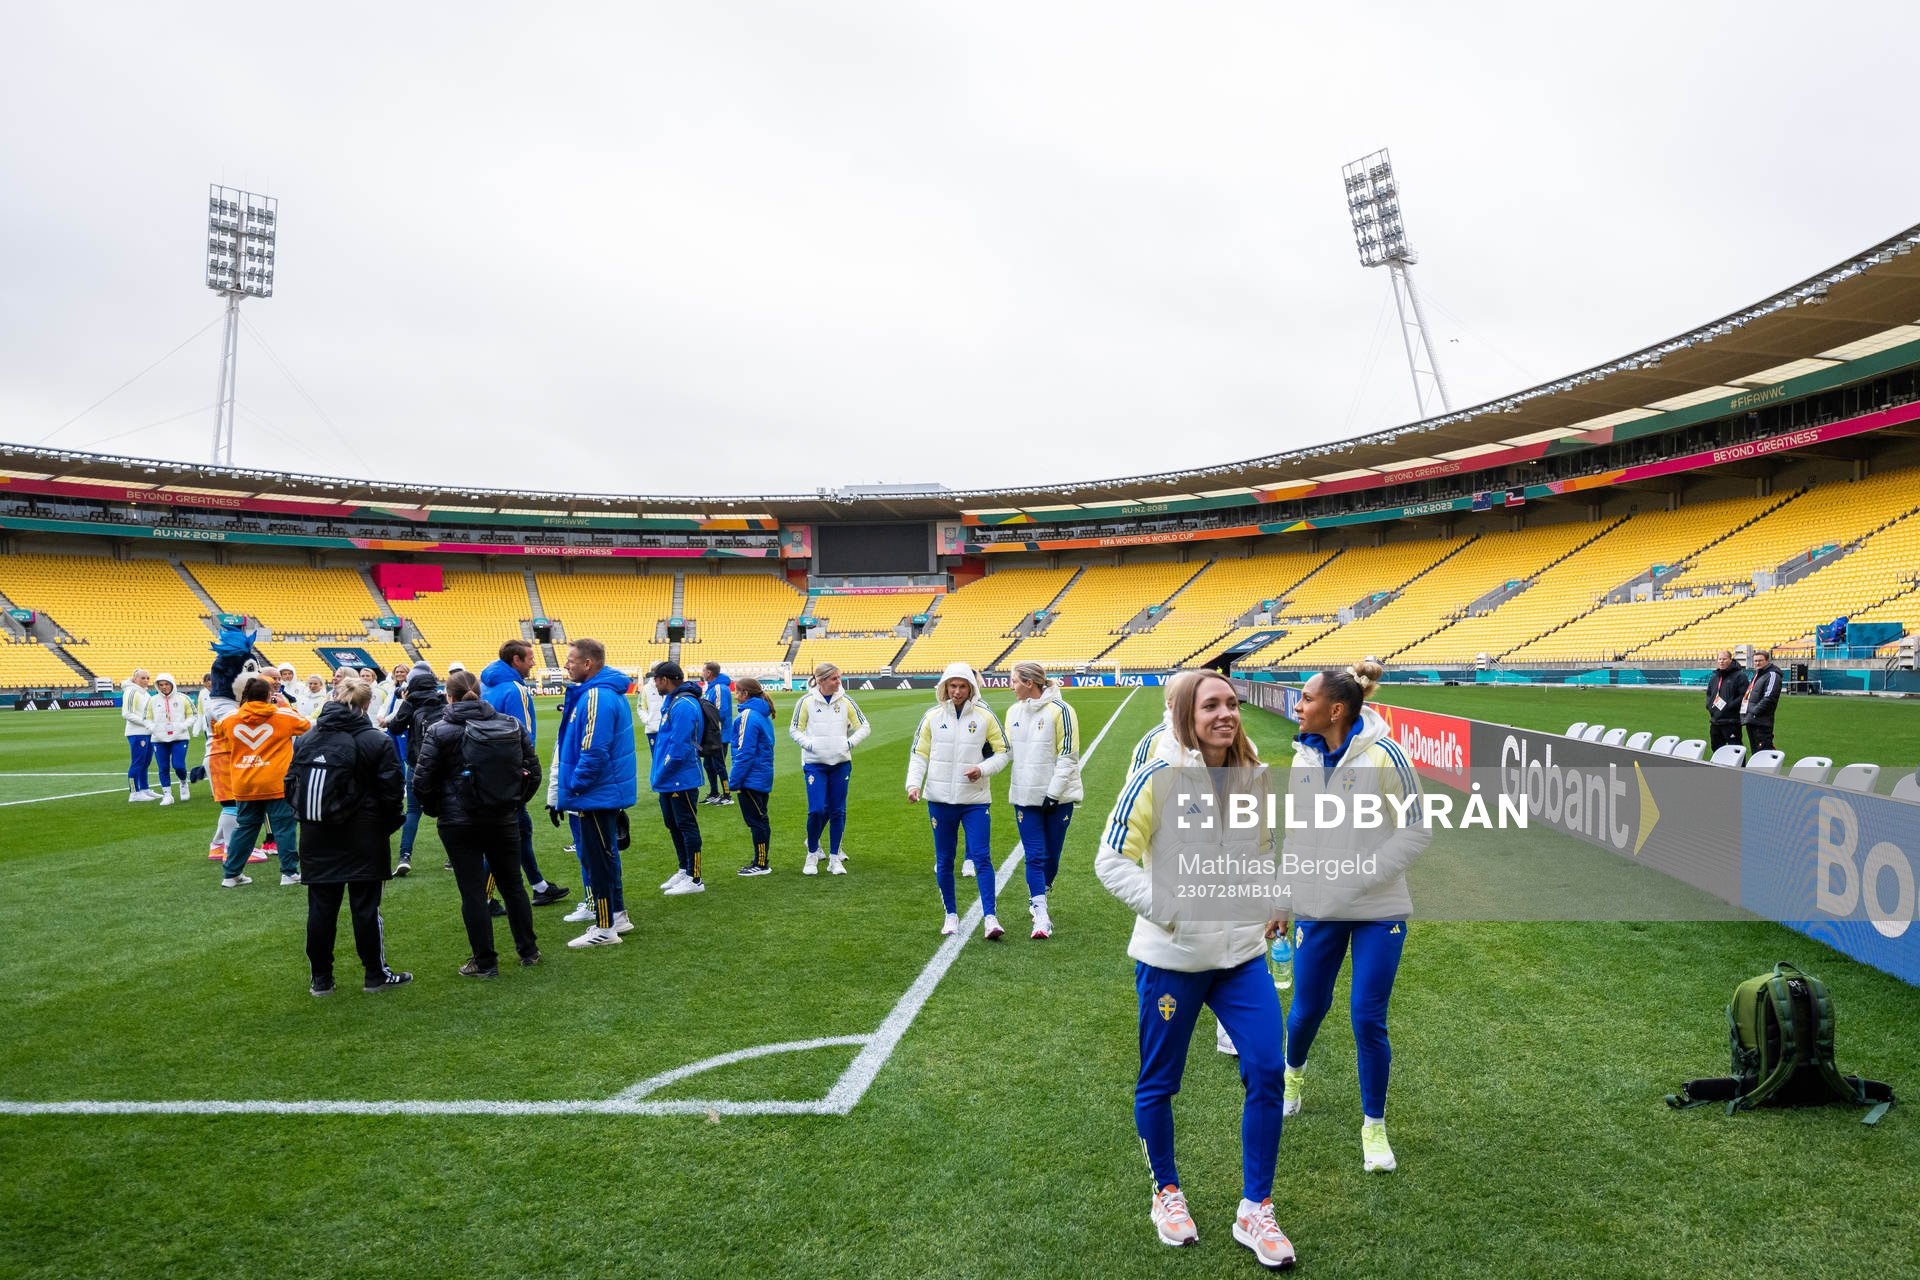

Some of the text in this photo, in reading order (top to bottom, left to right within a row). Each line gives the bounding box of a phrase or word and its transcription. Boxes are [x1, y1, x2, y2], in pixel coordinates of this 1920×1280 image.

[1730, 385, 1787, 409] #FIFAWWC
[1713, 430, 1819, 462] BEYOND GREATNESS
[1384, 463, 1460, 483] BEYOND GREATNESS
[126, 490, 241, 507] BEYOND GREATNESS
[543, 518, 591, 526] #FIFAWWC
[1116, 536, 1151, 545] WOMEN'S
[1151, 534, 1178, 543] WORLD
[1178, 532, 1195, 541] CUP
[524, 546, 613, 556] BEYOND GREATNESS
[1074, 676, 1104, 687] VISA
[1114, 675, 1143, 687] VISA
[68, 699, 114, 708] QATAR AIRWAYS
[1401, 723, 1463, 776] McDonald's
[1501, 735, 1629, 849] Globant
[1816, 795, 1920, 939] Bo
